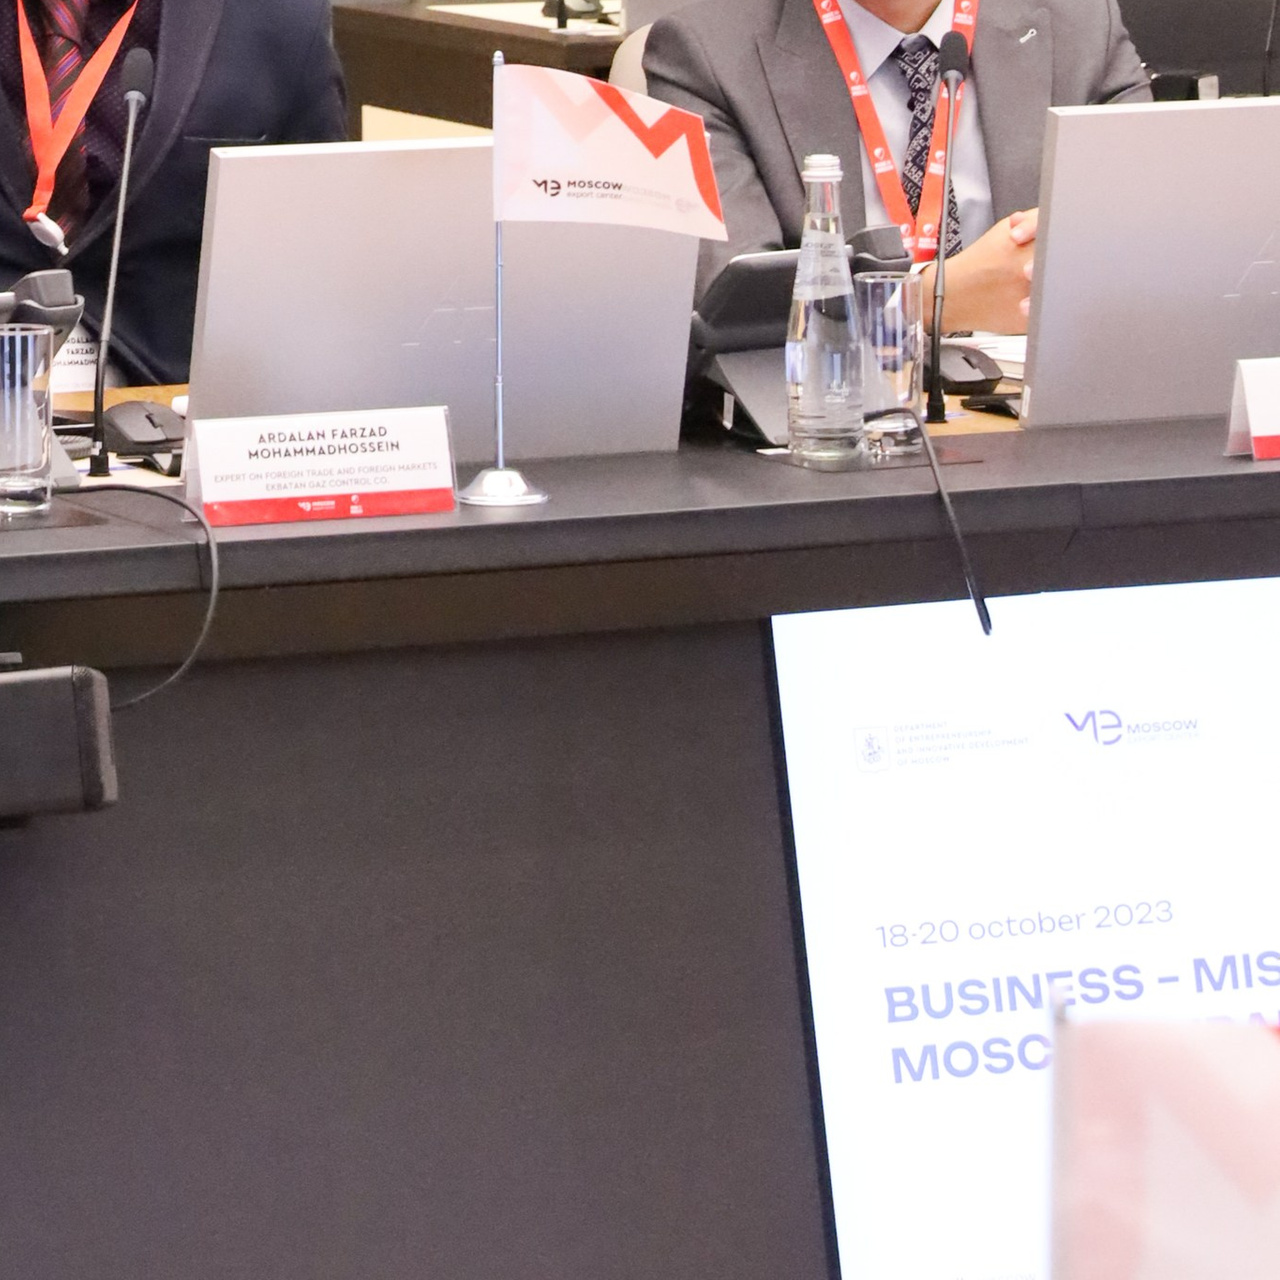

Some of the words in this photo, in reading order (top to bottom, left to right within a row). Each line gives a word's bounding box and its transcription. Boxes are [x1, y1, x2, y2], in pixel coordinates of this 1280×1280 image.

[567, 180, 623, 190] MOSCOW
[567, 191, 593, 199] export
[258, 429, 326, 444] ARDALAN
[331, 426, 388, 440] FARZAD
[248, 440, 400, 460] MOHAMMADHOSSEIN
[214, 473, 246, 483] EXPERT
[248, 472, 263, 481] ON
[265, 470, 304, 480] FOREIGN
[307, 468, 334, 477] TRADE
[337, 466, 355, 476] AND
[358, 464, 396, 474] FOREIGN
[398, 462, 438, 472] MARKETS
[265, 481, 306, 491] EKBATAN
[308, 480, 327, 489] GAZ
[329, 477, 371, 487] CONTROL
[1126, 719, 1198, 734] MOSCOW
[875, 920, 959, 948] 18-20
[969, 911, 1087, 941] october
[1093, 900, 1174, 929] 2023
[884, 964, 1144, 1023] BUSINESS
